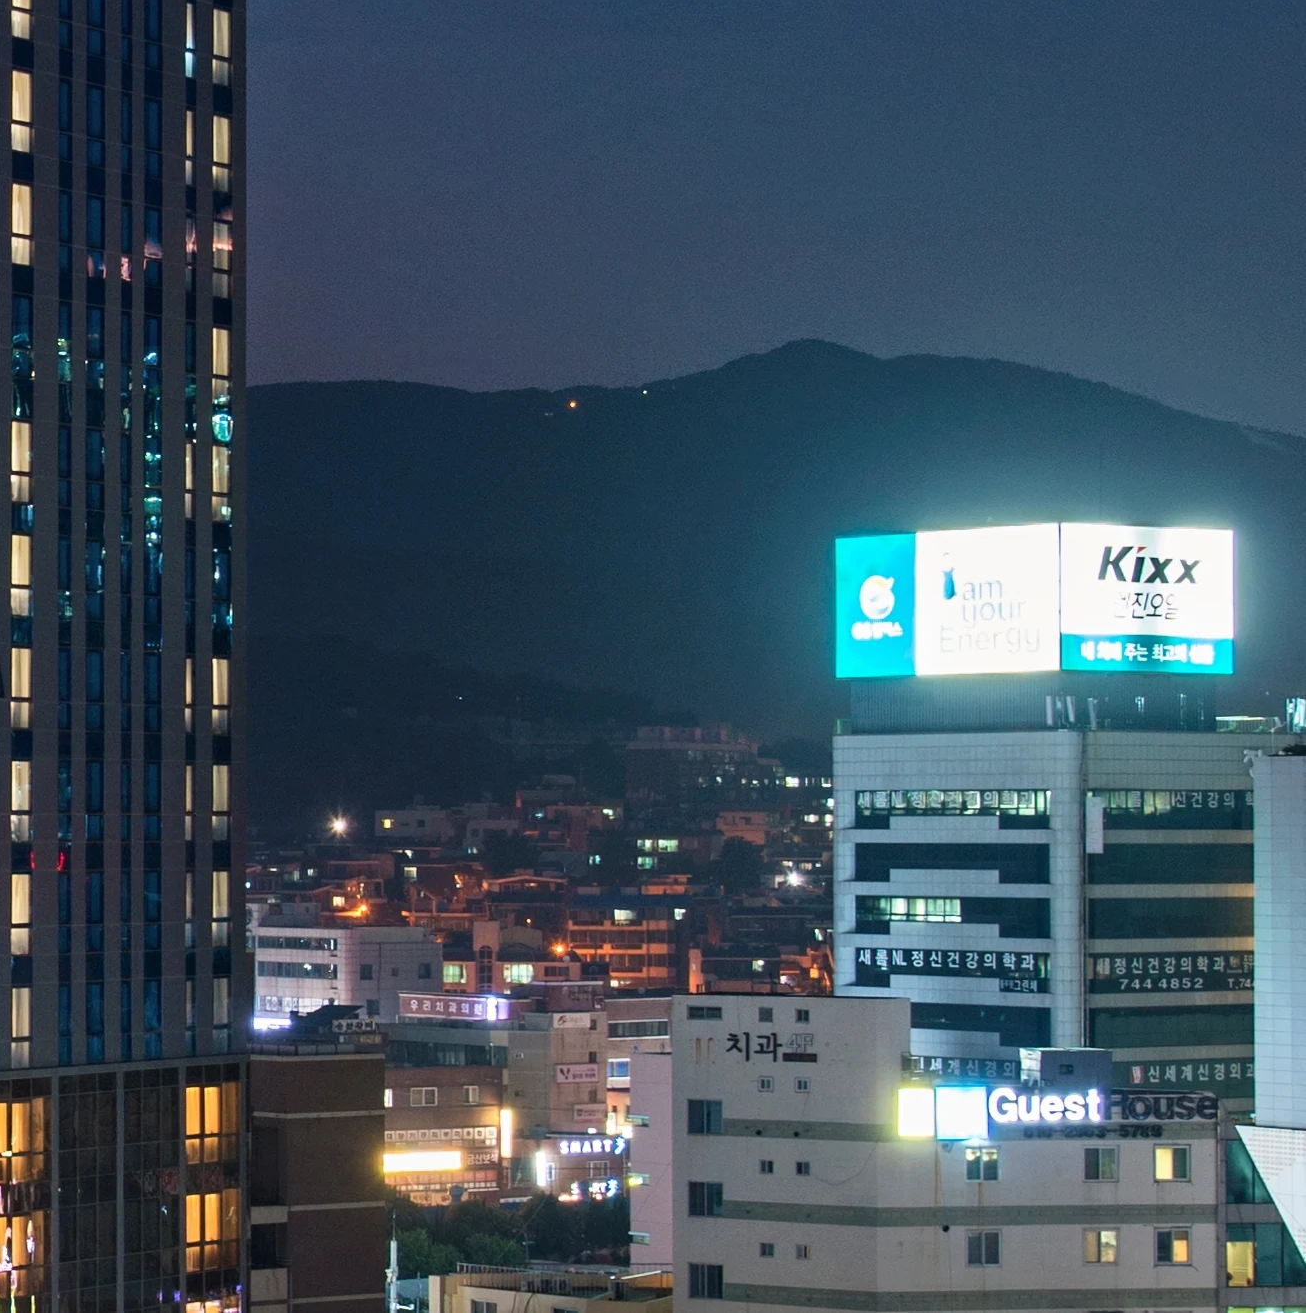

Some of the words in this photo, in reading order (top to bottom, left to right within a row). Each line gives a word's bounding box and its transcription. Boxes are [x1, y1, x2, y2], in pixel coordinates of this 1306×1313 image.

[1097, 545, 1201, 584] Kixx
[962, 579, 1004, 601] am
[961, 599, 1027, 629] your
[939, 623, 1041, 655] Energy
[1124, 642, 1149, 662] 주는
[1114, 956, 1225, 975] 정신건강의학과
[1119, 978, 1153, 990] 744
[1158, 977, 1204, 990] 4852
[410, 1000, 483, 1016] 우리치과의원
[725, 1032, 782, 1063] 치과
[786, 1033, 814, 1053] 4F
[988, 1087, 1102, 1123] Guest
[1105, 1090, 1219, 1121] House
[560, 1139, 613, 1155] SMART
